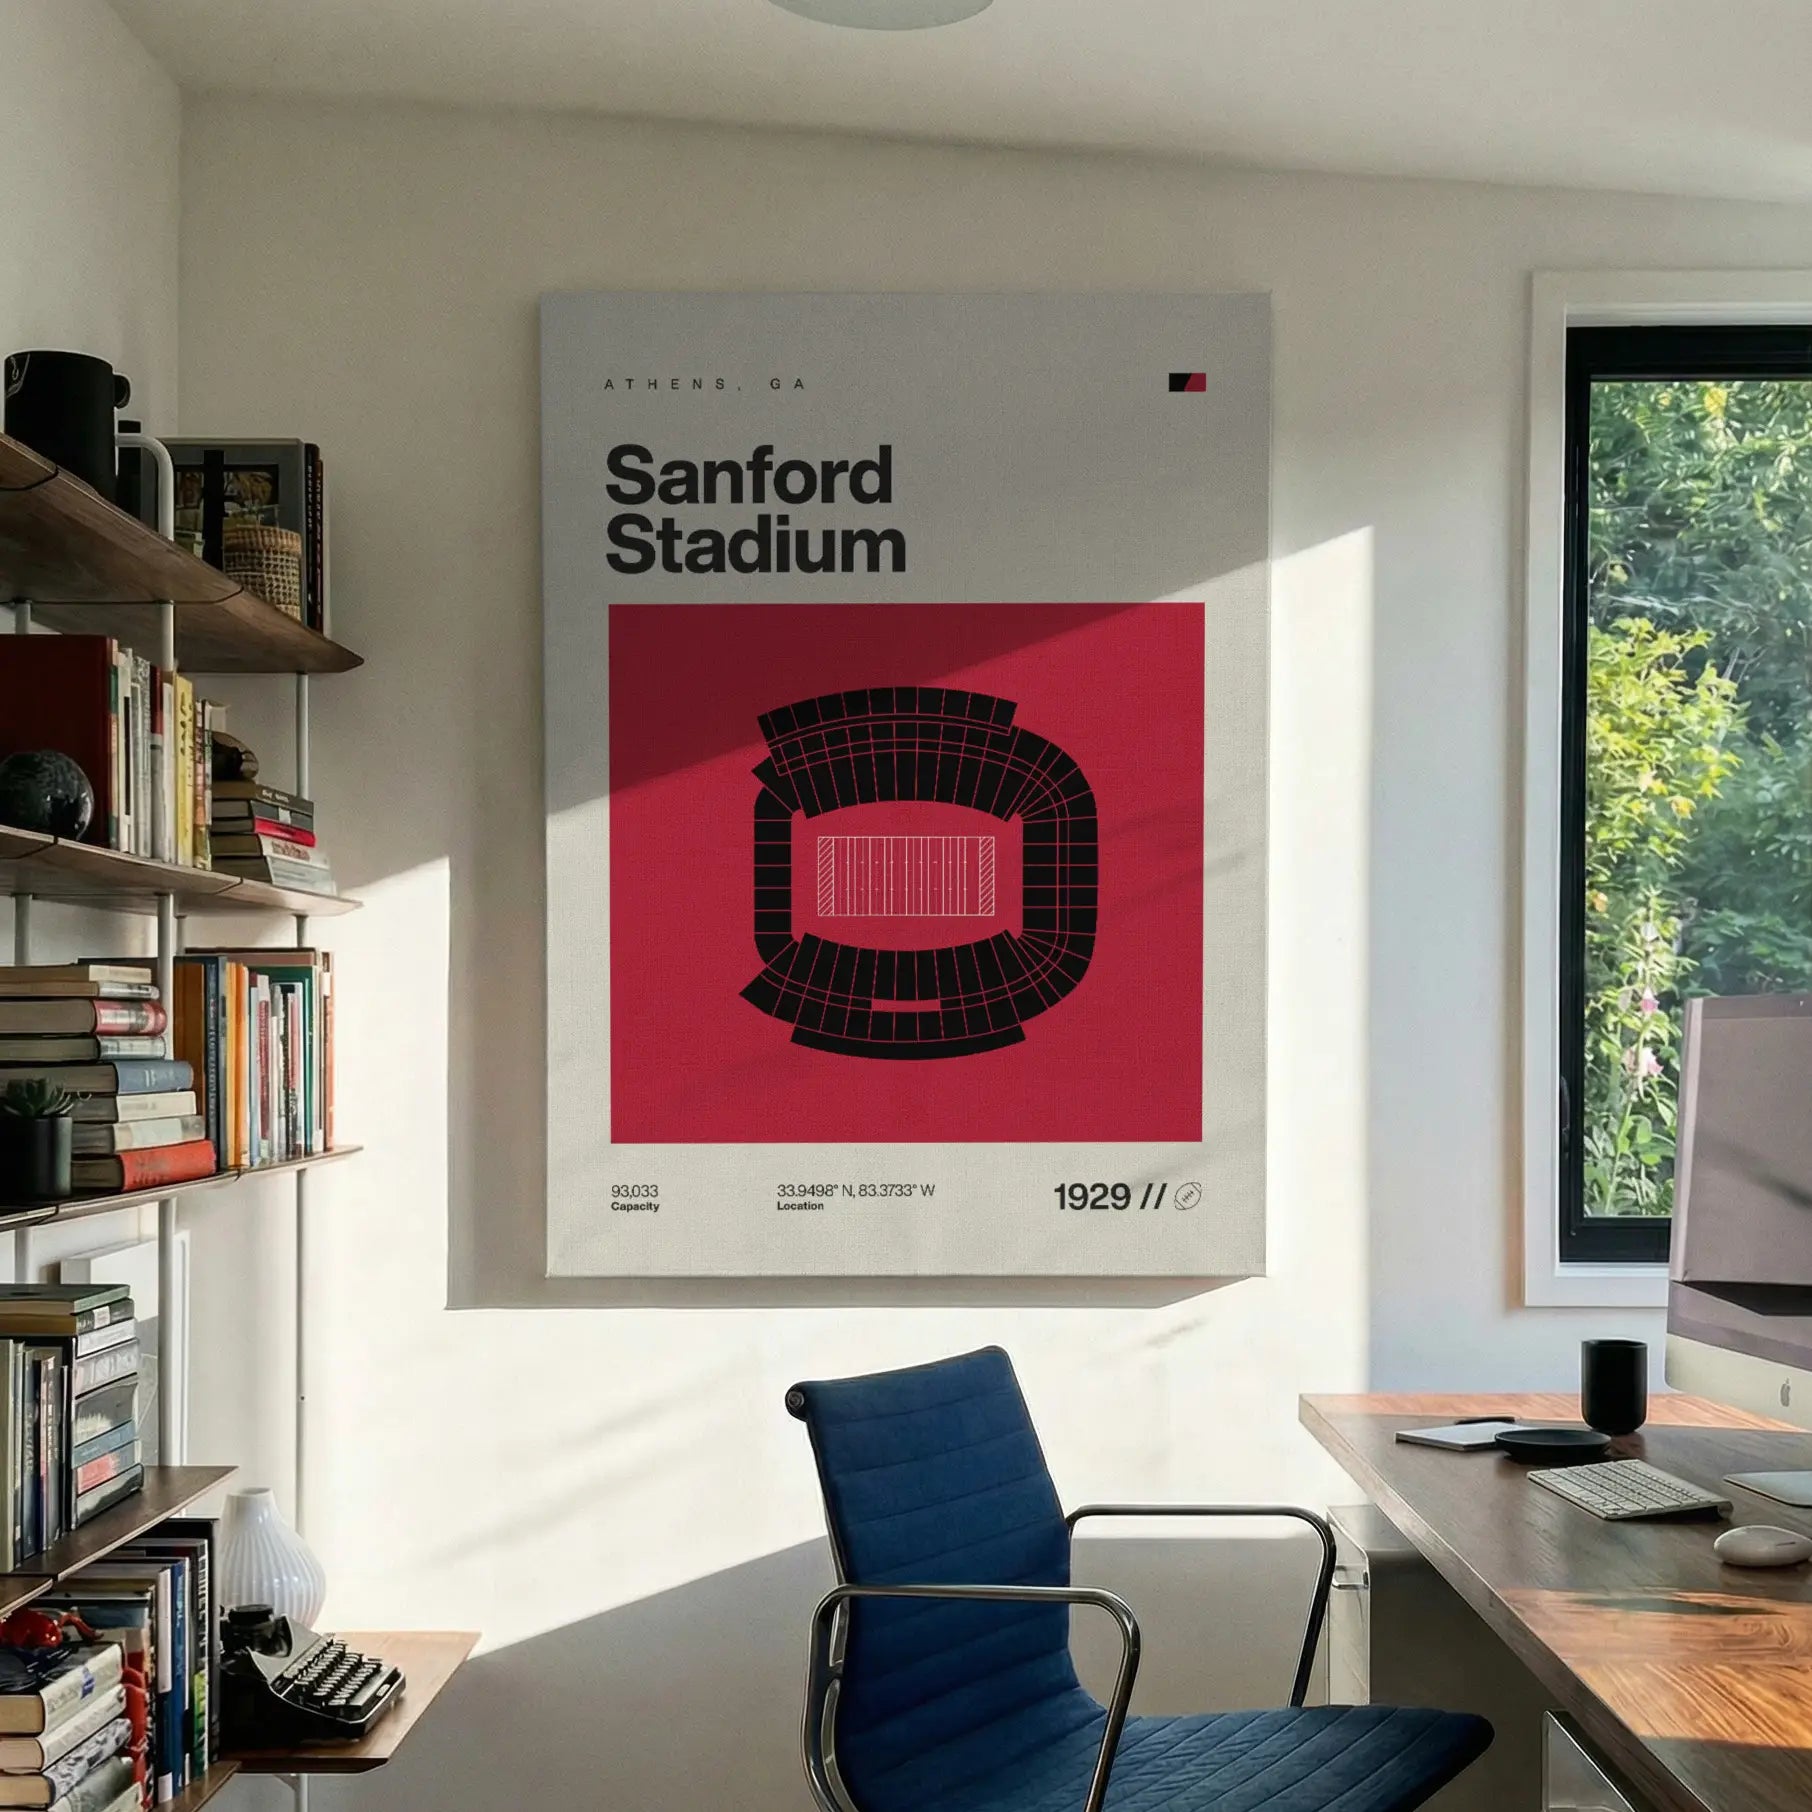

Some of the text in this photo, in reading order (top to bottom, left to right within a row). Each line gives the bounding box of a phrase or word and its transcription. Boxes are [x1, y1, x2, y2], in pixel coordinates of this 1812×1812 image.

[604, 377, 806, 392] ATHENS, GA
[606, 443, 893, 506] Sanford
[606, 512, 907, 575] Stadium
[611, 1184, 659, 1199] 93,033
[777, 1184, 935, 1198] 33.9498° N, 83.3733° W
[1055, 1182, 1132, 1211] 1929
[611, 1201, 660, 1213] Capacity
[776, 1201, 825, 1211] Location
